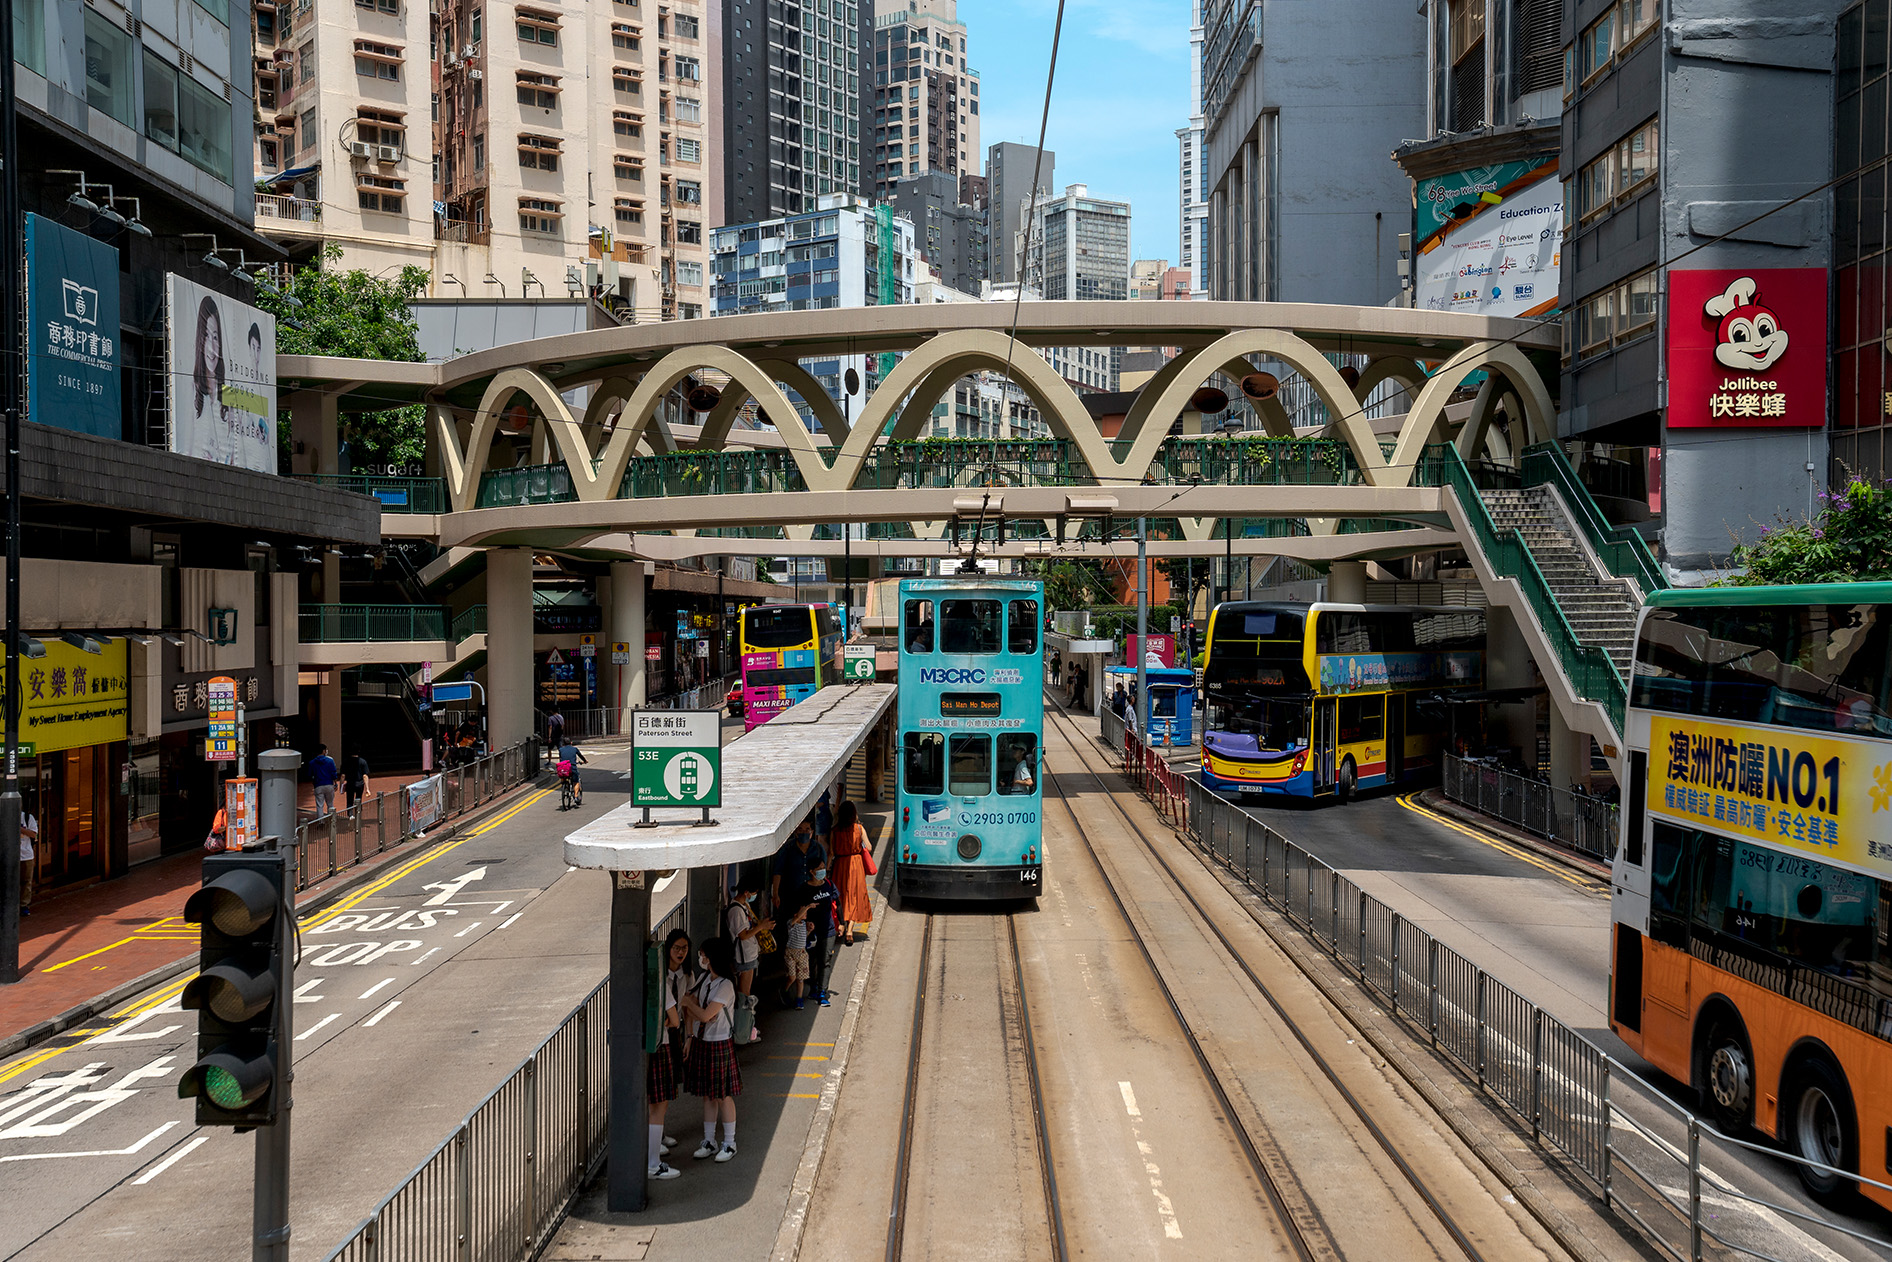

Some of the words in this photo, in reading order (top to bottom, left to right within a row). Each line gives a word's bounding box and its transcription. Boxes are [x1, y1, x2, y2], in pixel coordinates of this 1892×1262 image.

[1428, 185, 1446, 203] 68
[1446, 188, 1460, 199] Yee
[1460, 185, 1474, 197] Wo
[1473, 181, 1498, 193] Street
[1500, 206, 1550, 219] Education
[47, 320, 113, 358] 商務印書館
[48, 344, 60, 356] THE
[58, 374, 81, 390] SINCE
[86, 382, 103, 395] 1897
[1718, 376, 1778, 391] Jollibee
[1709, 393, 1786, 418] 快樂蜂
[908, 581, 925, 591] 146
[1021, 581, 1037, 591] 146
[920, 668, 986, 684] M3CRC
[941, 701, 953, 709] Sai
[955, 701, 968, 709] Wan
[969, 701, 979, 709] Ho
[980, 701, 999, 710] Depot
[29, 715, 39, 728] My
[39, 715, 56, 725] Sweet
[57, 711, 74, 723] Home
[74, 707, 108, 722] Employment
[108, 706, 127, 718] Agency
[638, 717, 686, 728] 百德新街
[217, 742, 226, 750] 11
[638, 751, 659, 760] 53E
[974, 813, 1003, 824] 2903
[1007, 812, 1036, 824] 0700
[1020, 869, 1037, 881] 146
[307, 909, 459, 934] BUS
